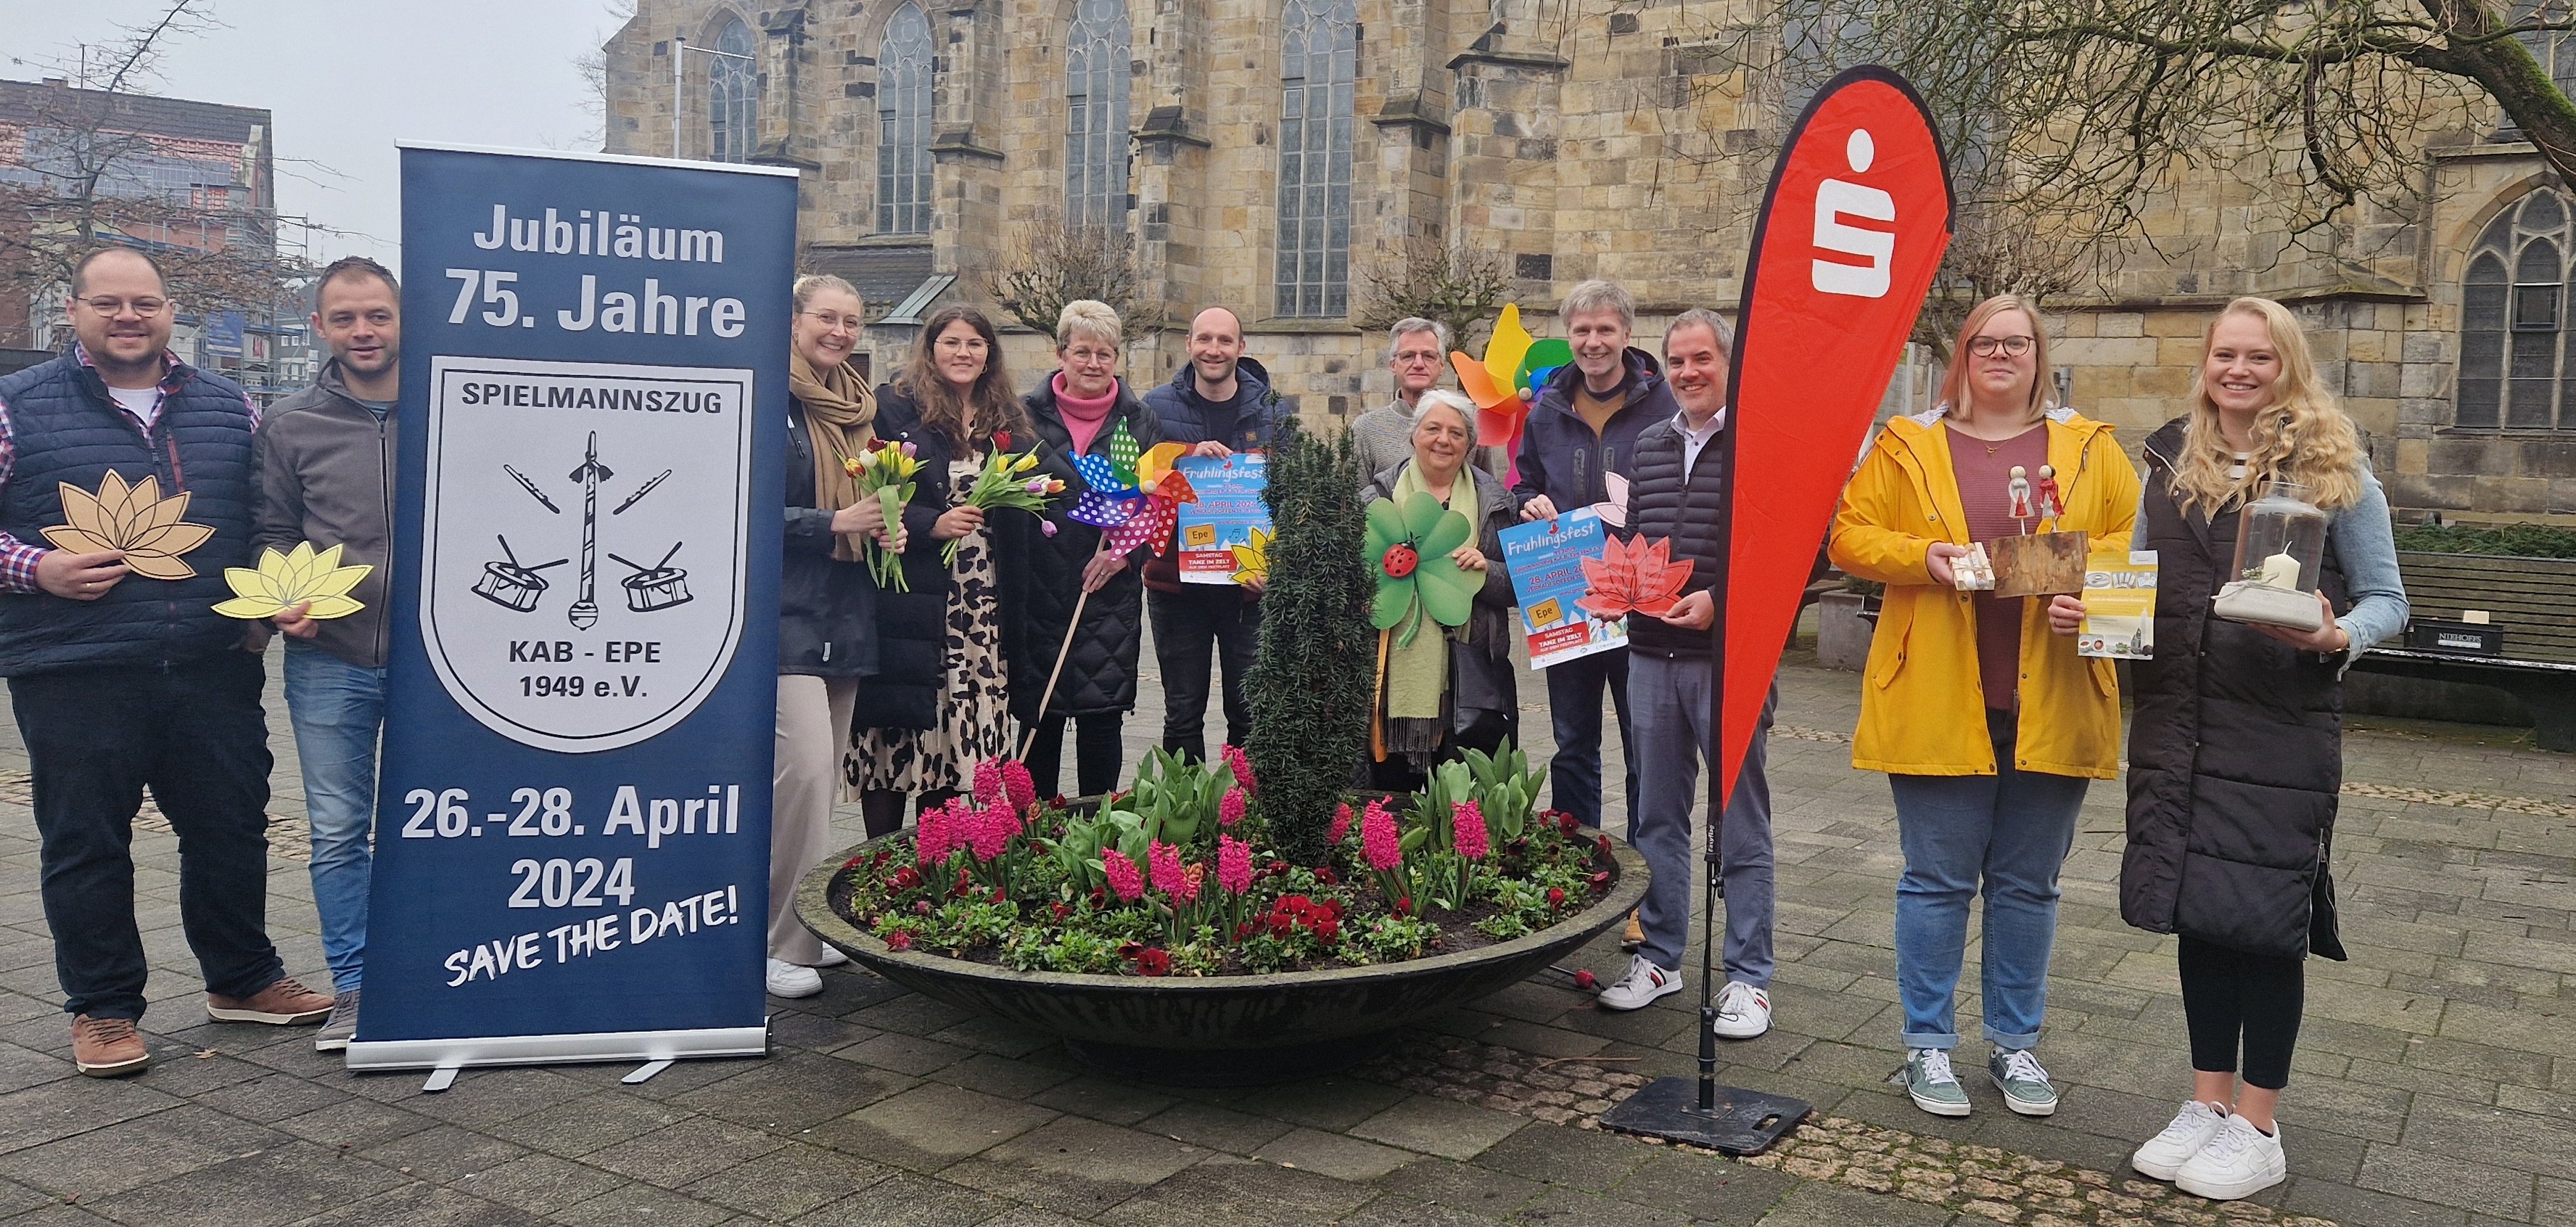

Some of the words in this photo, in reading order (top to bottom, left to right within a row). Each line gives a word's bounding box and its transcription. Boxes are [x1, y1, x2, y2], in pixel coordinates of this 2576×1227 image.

[473, 204, 723, 263] Jubiläum
[445, 268, 535, 328] 75.
[557, 274, 746, 338] Jahre
[461, 382, 722, 414] SPIELMANNSZUG
[1192, 530, 1209, 540] Epe
[1529, 575, 1543, 585] 28.
[1545, 568, 1572, 580] APRIL
[1536, 607, 1553, 618] Epe
[1538, 639, 1556, 648] TANZ
[1566, 632, 1582, 641] ZELT
[1544, 627, 1573, 639] SAMSTAG
[2439, 633, 2482, 643] NIEHOFFS
[509, 640, 574, 662] KAB
[605, 641, 662, 663] EPE
[519, 676, 584, 697] 1949
[594, 675, 648, 697] e.V.
[401, 787, 585, 839] 26.-28.
[602, 784, 740, 849] April
[509, 858, 636, 908] 2024
[444, 931, 543, 988] SAVE
[547, 914, 622, 964] THE
[630, 885, 739, 945] DATE!
